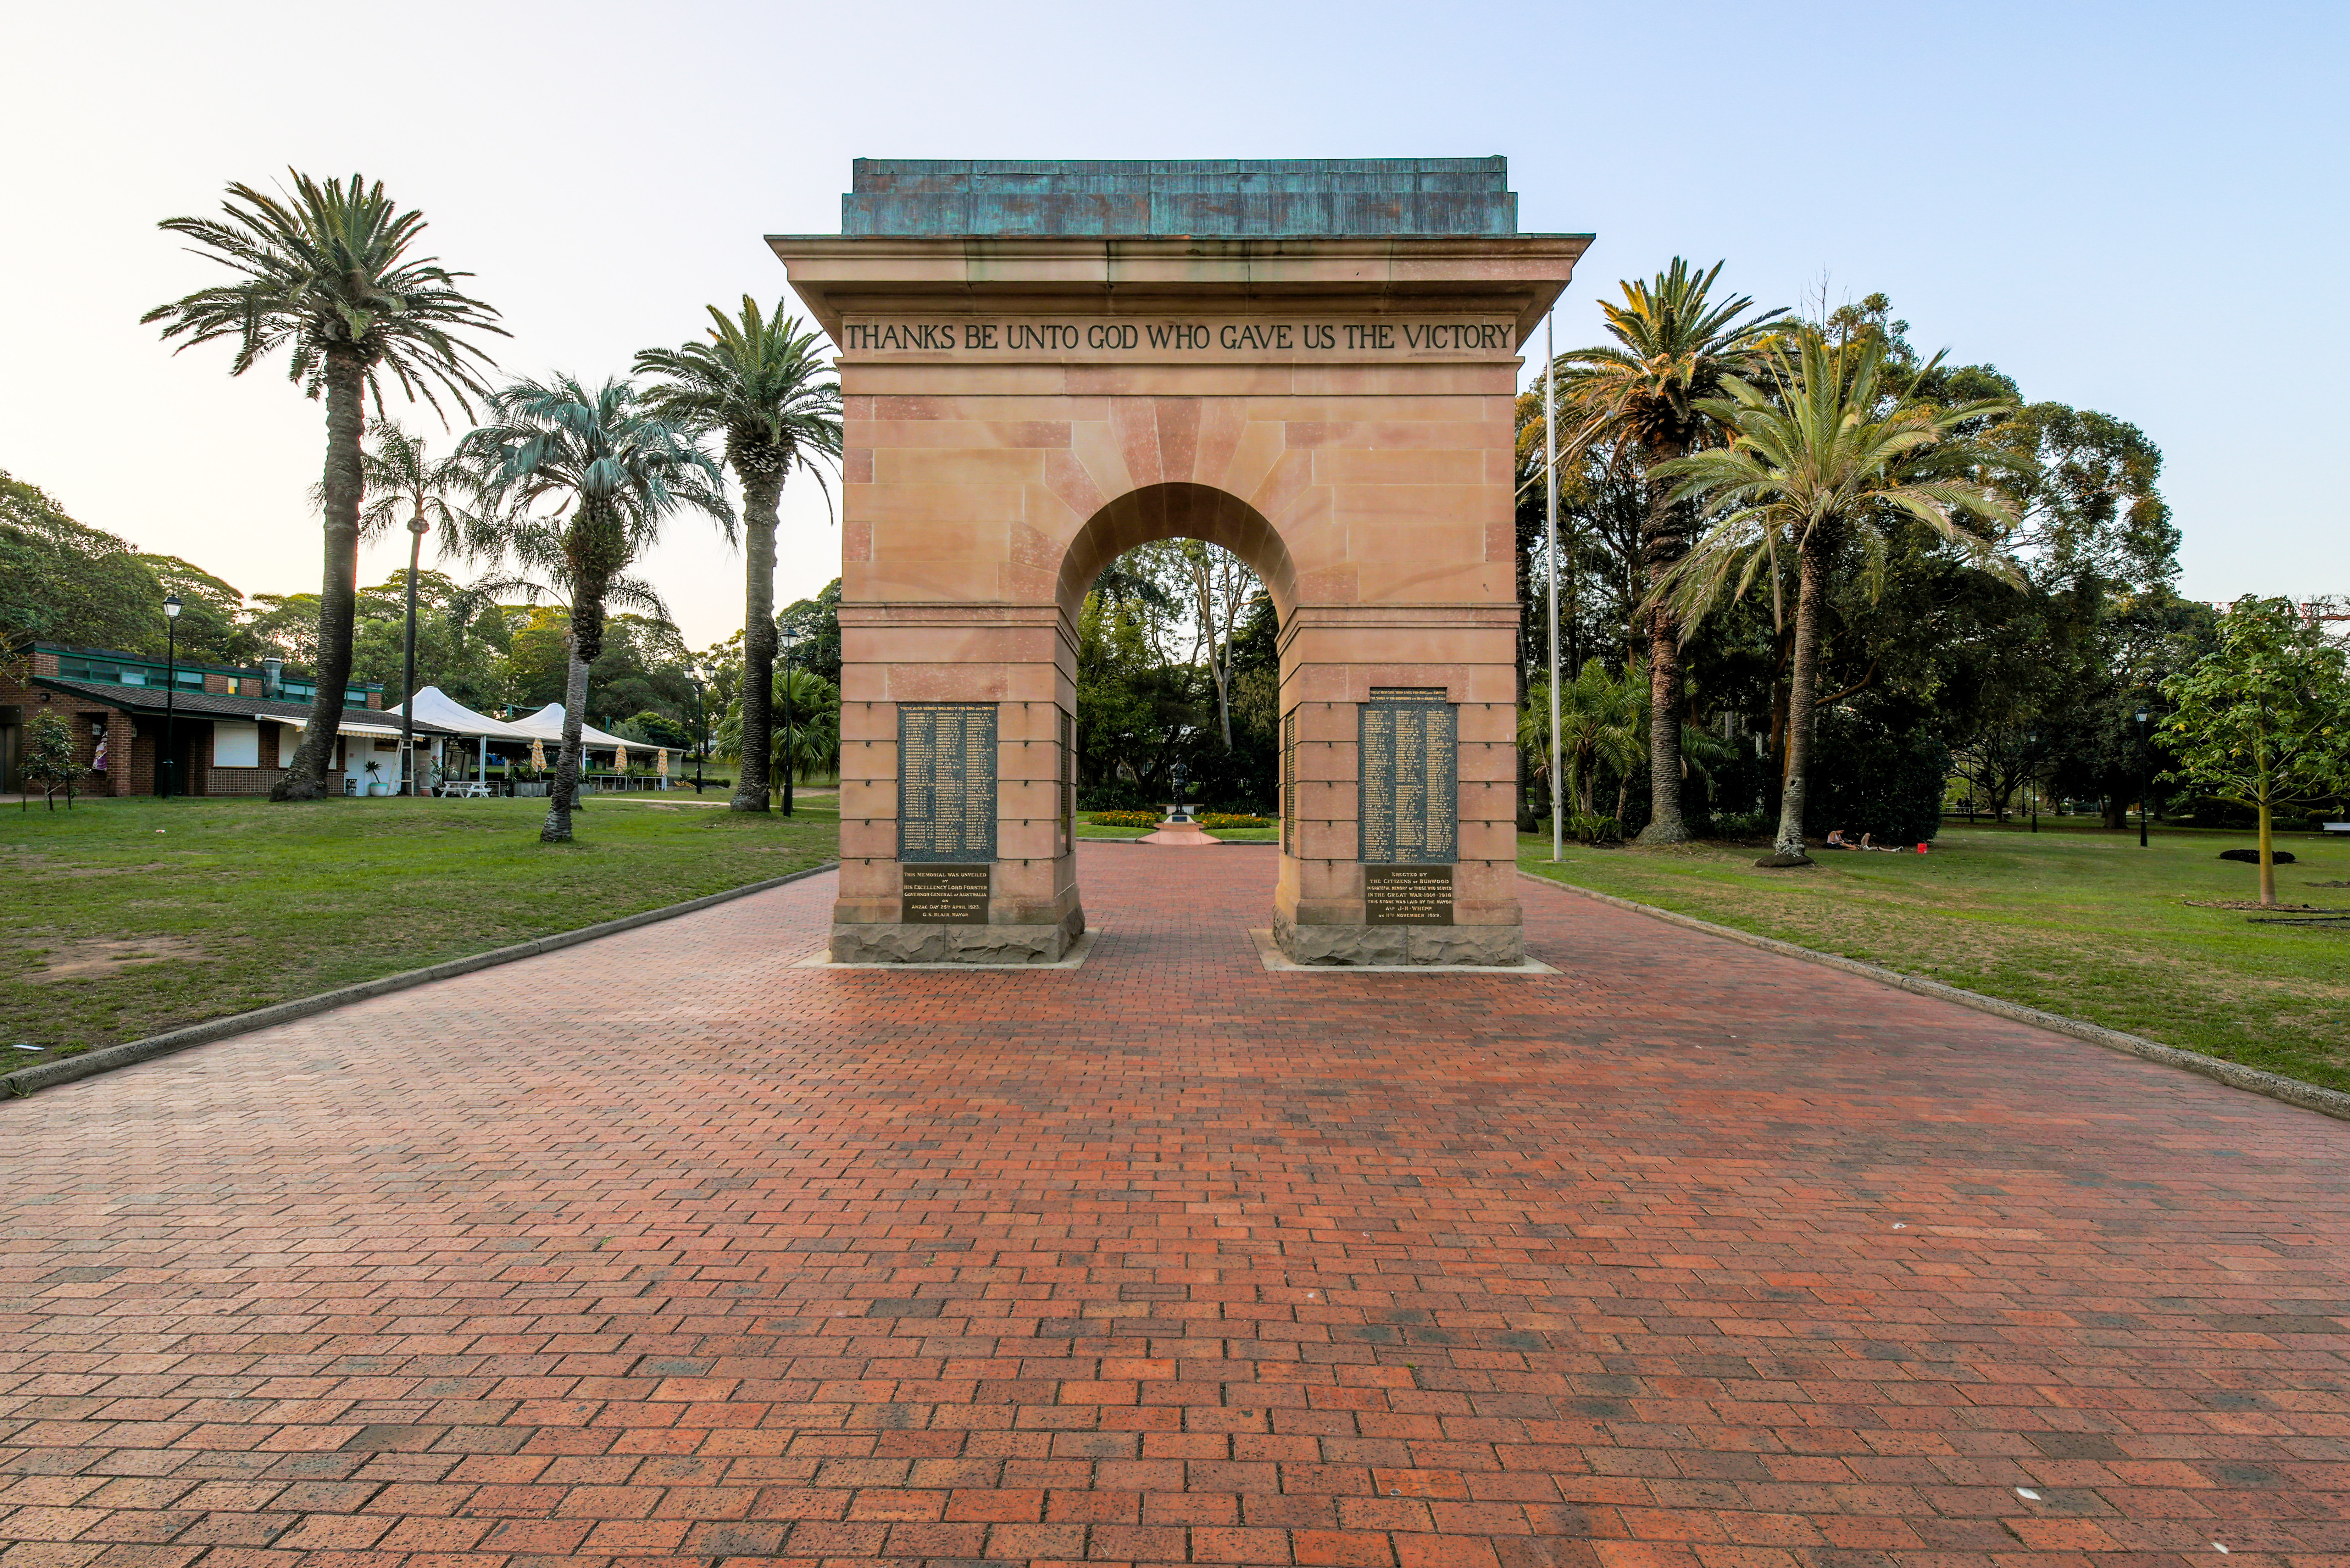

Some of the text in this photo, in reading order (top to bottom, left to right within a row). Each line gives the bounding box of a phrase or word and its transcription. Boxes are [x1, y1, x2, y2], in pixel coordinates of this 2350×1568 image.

[845, 324, 1514, 349] THANKS BE UNTO GOD WHO GAVE US THE VICTORY
